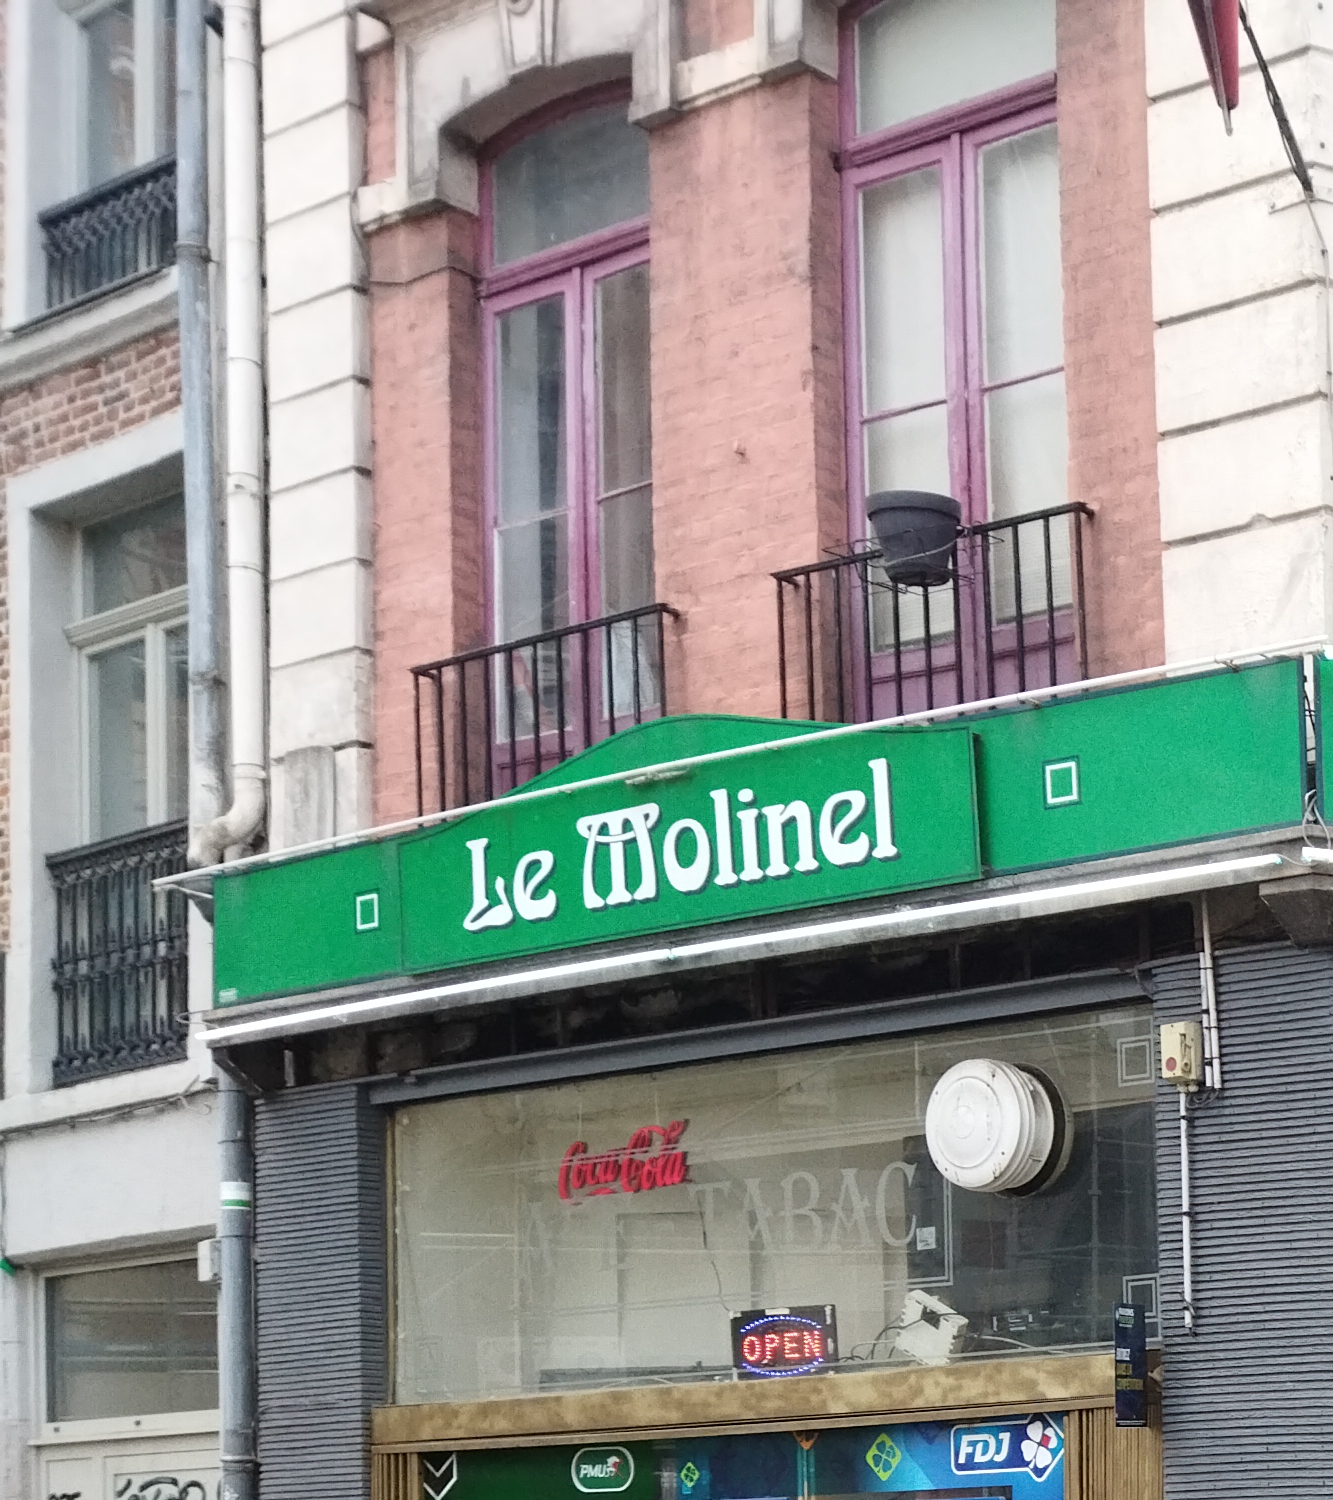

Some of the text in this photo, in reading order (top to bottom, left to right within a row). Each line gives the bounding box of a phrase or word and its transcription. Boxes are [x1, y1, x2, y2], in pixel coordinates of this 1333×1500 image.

[462, 757, 900, 934] Le Molinel
[689, 1159, 918, 1255] TABAC
[741, 1330, 823, 1364] OPEN
[957, 1433, 1010, 1464] FDJ
[579, 1464, 607, 1479] PMU
